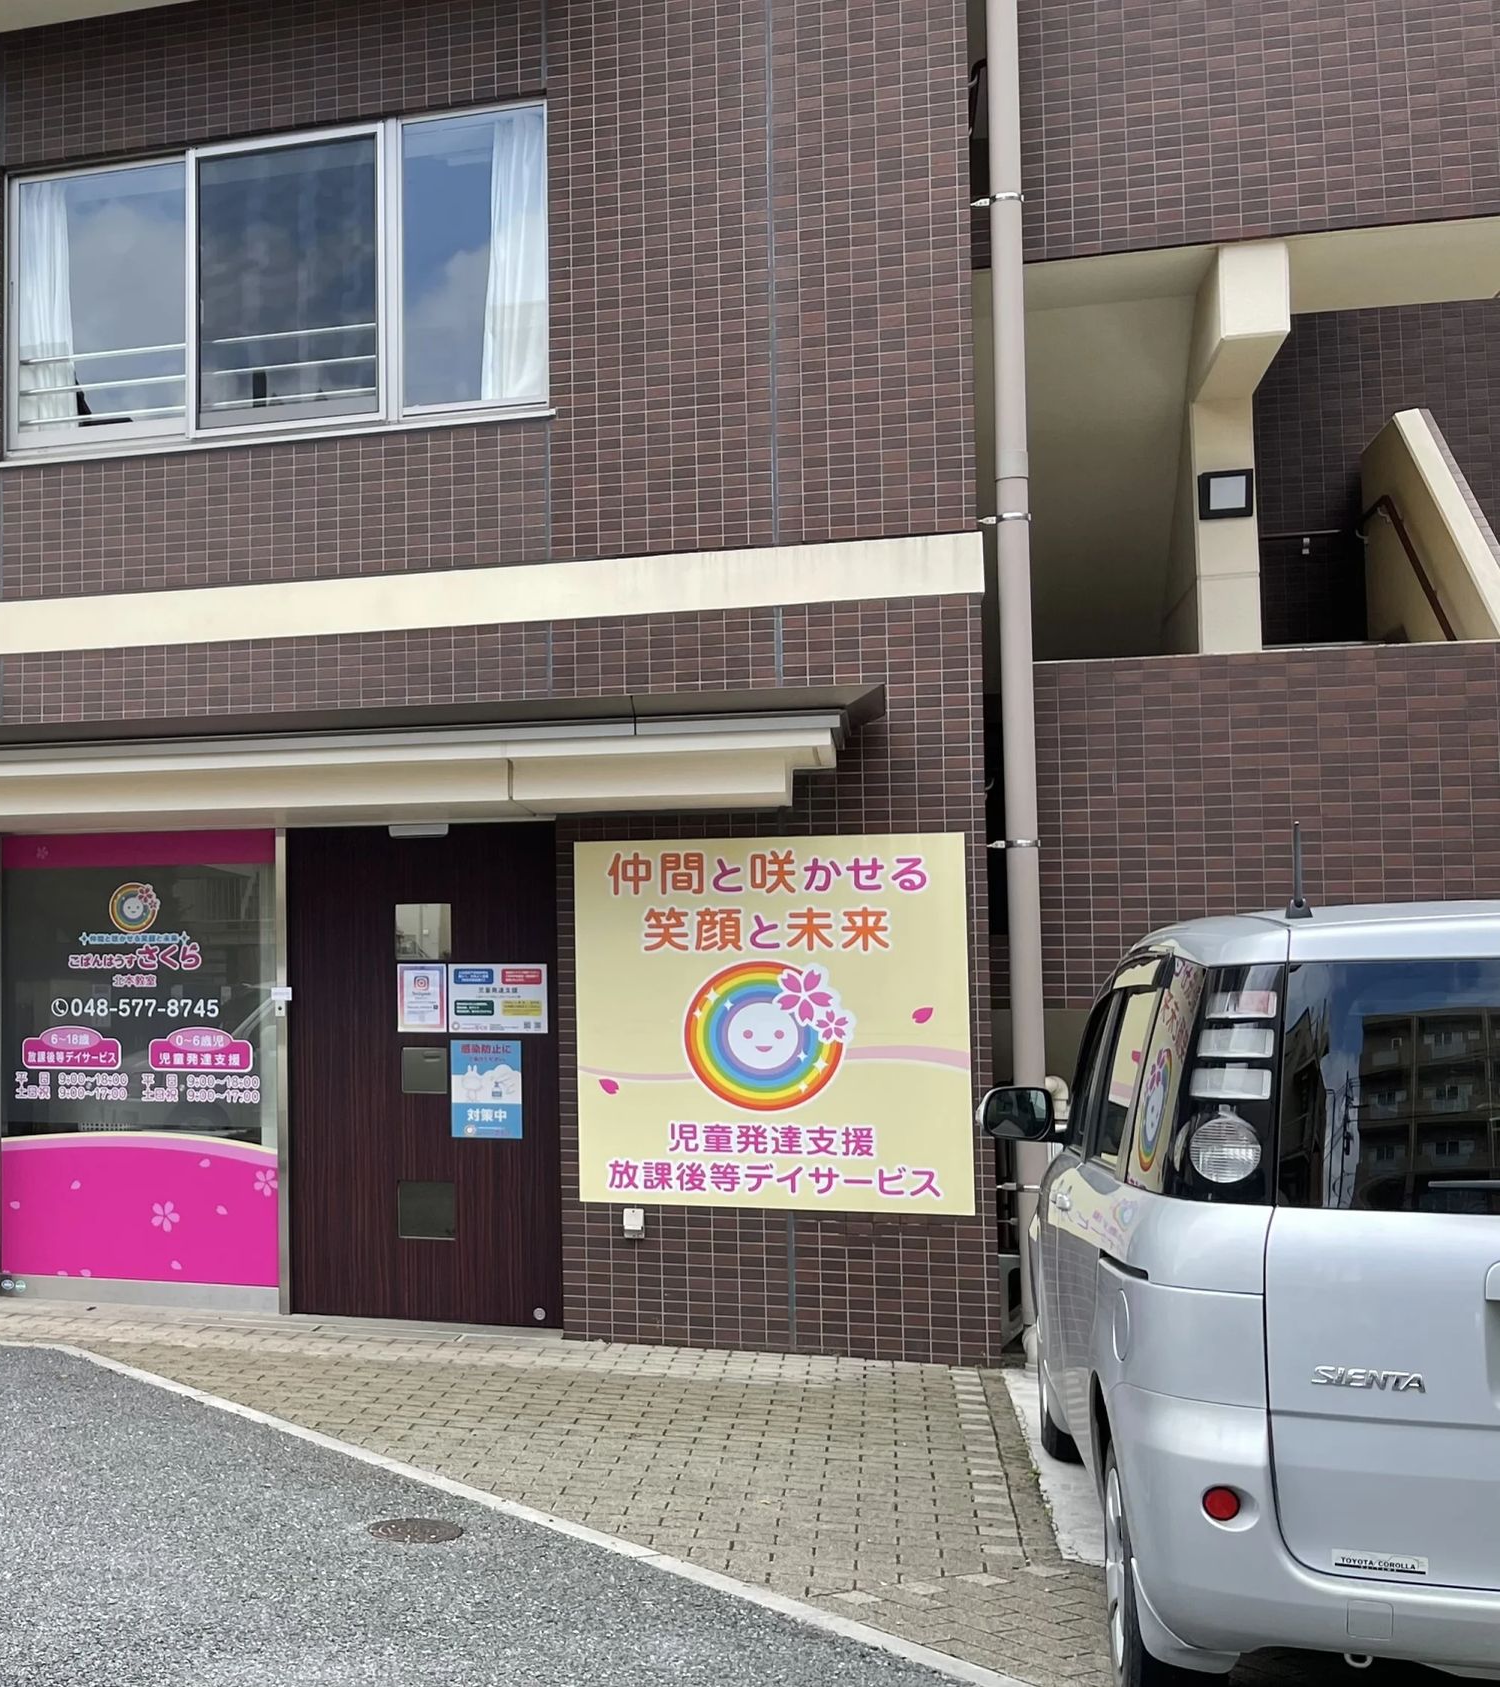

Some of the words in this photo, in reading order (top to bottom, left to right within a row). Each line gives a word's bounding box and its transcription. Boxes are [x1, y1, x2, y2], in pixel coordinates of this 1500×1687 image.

[607, 849, 930, 896] 仲間と咲かせる
[642, 906, 891, 952] 笑顔と未来
[71, 998, 220, 1018] 048-577-8745
[27, 1051, 117, 1064] 放課後等デイサービス
[158, 1052, 241, 1066] 児童発達支援
[467, 1108, 507, 1122] 対策中
[668, 1123, 875, 1157] 児童発達支援
[608, 1160, 942, 1198] 放課後等デイサービス
[1311, 1365, 1426, 1393] SIENTA
[1341, 1556, 1374, 1566] TOYOTA
[1378, 1560, 1416, 1570] COROLLA
